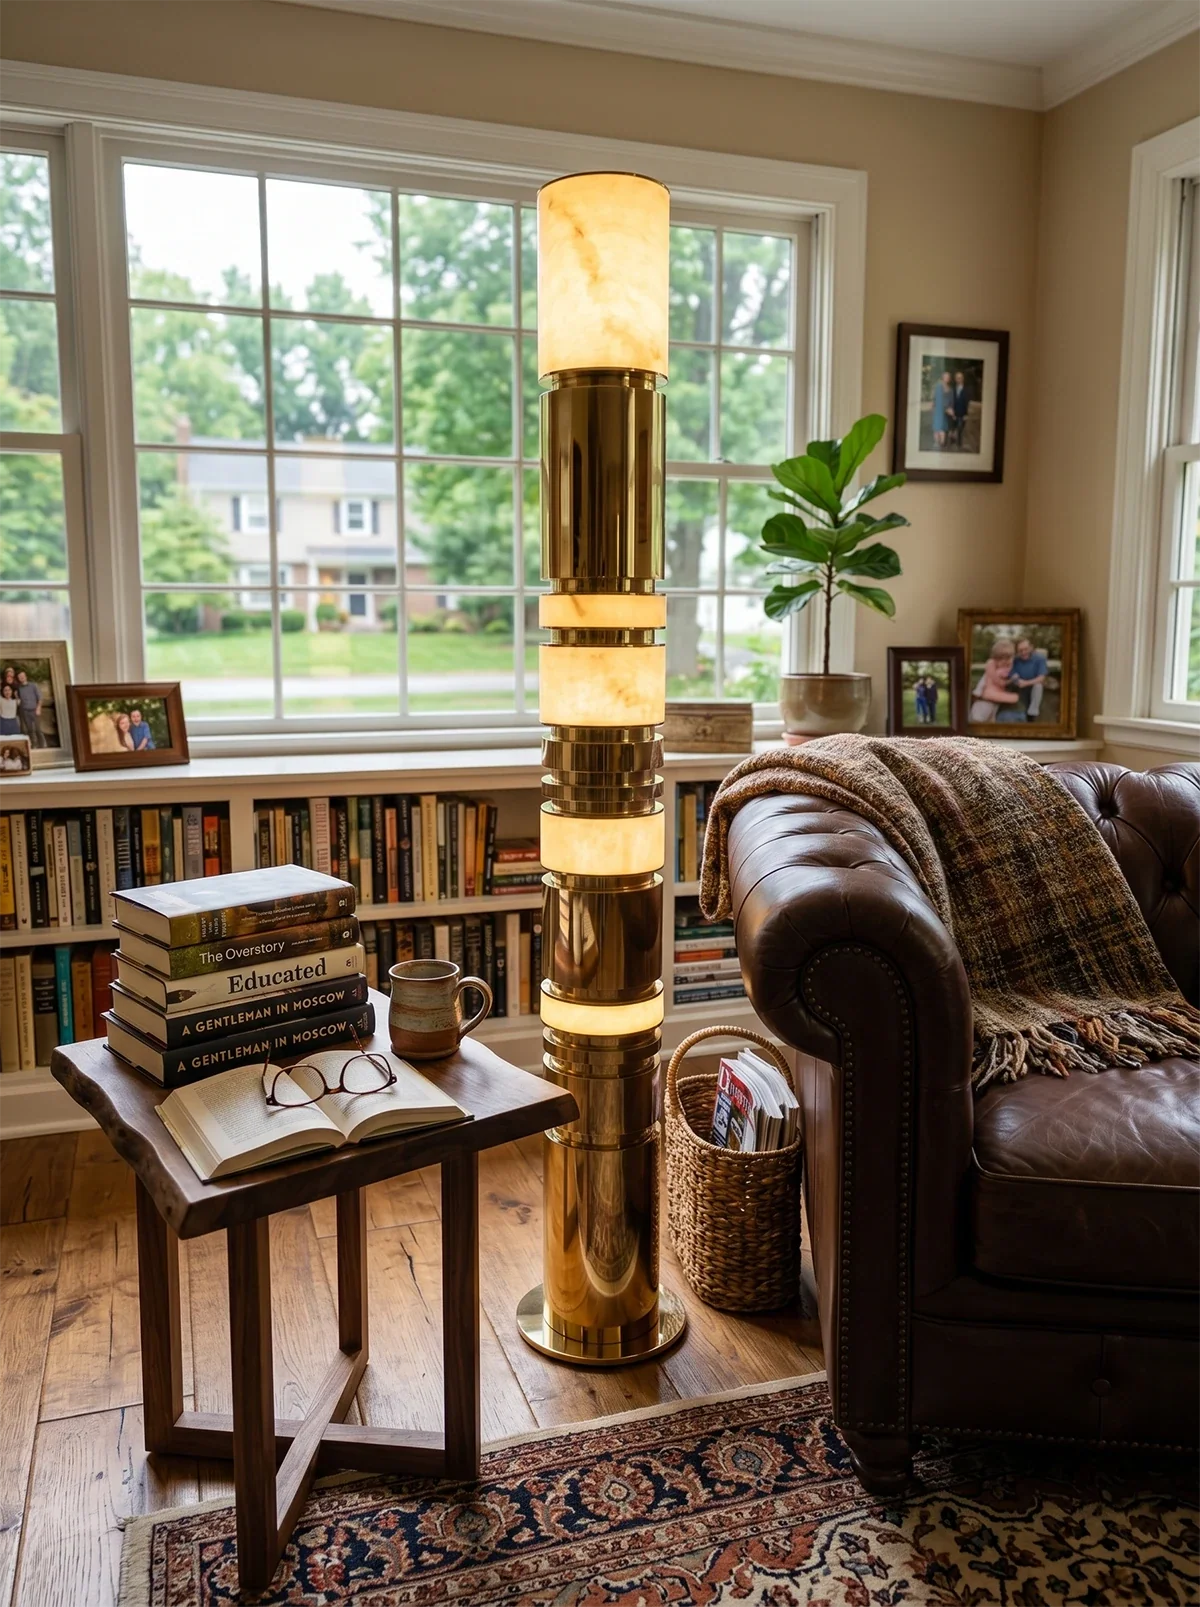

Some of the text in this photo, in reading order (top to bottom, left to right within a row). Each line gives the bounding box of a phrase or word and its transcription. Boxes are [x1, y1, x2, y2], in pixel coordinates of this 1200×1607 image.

[199, 952, 223, 965] The
[225, 941, 285, 960] Overstory
[227, 957, 328, 995] Educated
[182, 1025, 191, 1037] A
[195, 1006, 272, 1033] GENTLEMAN
[276, 1002, 289, 1015] IN
[293, 990, 345, 1010] MOSCOW
[177, 1061, 186, 1073] A
[191, 1040, 270, 1069] GENTLEMAN
[274, 1035, 288, 1048] IN
[292, 1021, 347, 1043] MOSCOW
